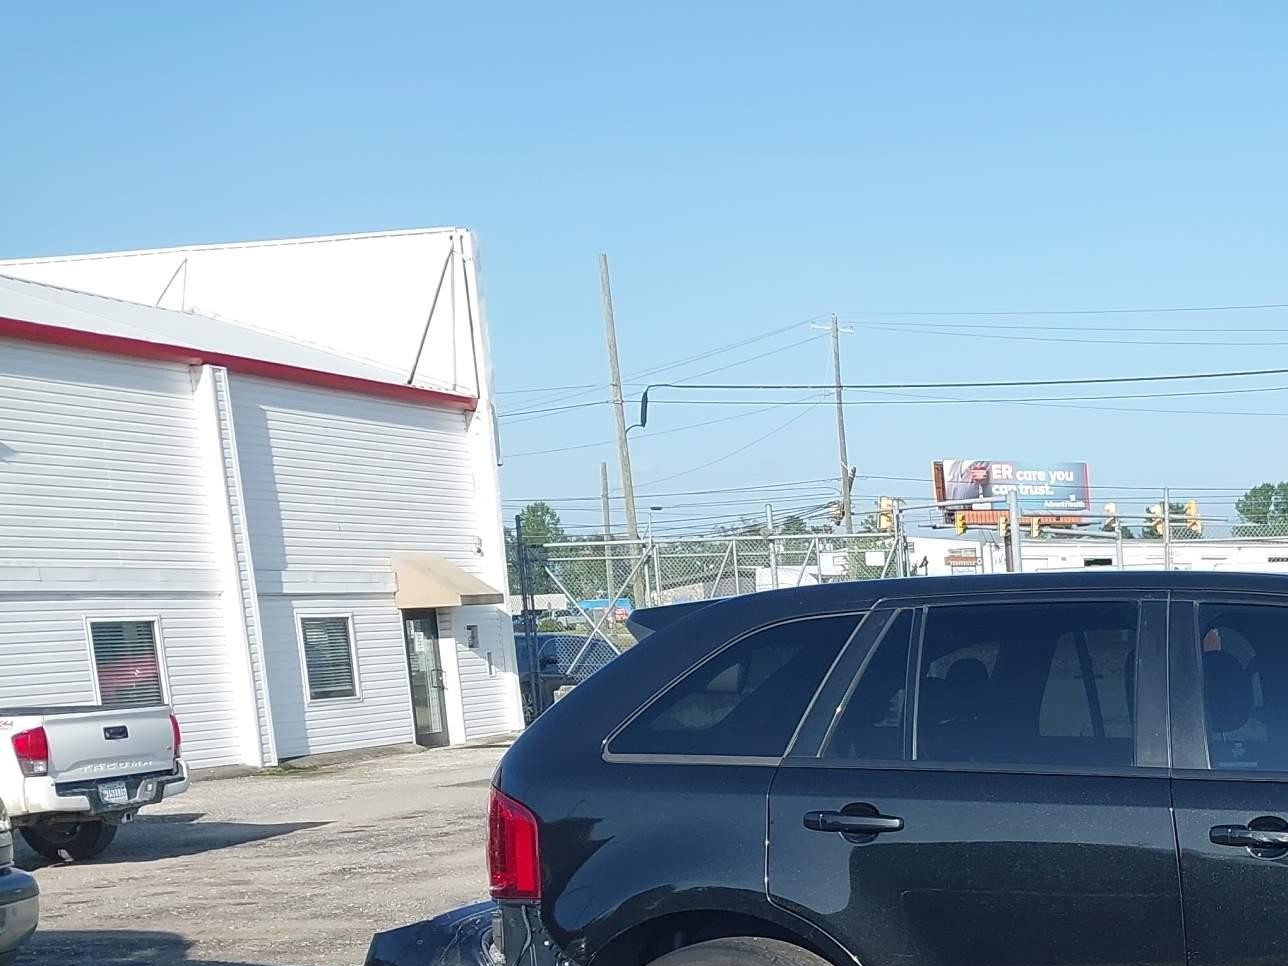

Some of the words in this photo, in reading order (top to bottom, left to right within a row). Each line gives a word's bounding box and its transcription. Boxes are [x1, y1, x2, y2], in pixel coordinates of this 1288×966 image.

[992, 464, 1013, 480] ER
[1016, 470, 1045, 481] care
[1048, 470, 1074, 485] you
[1018, 482, 1055, 496] trust.
